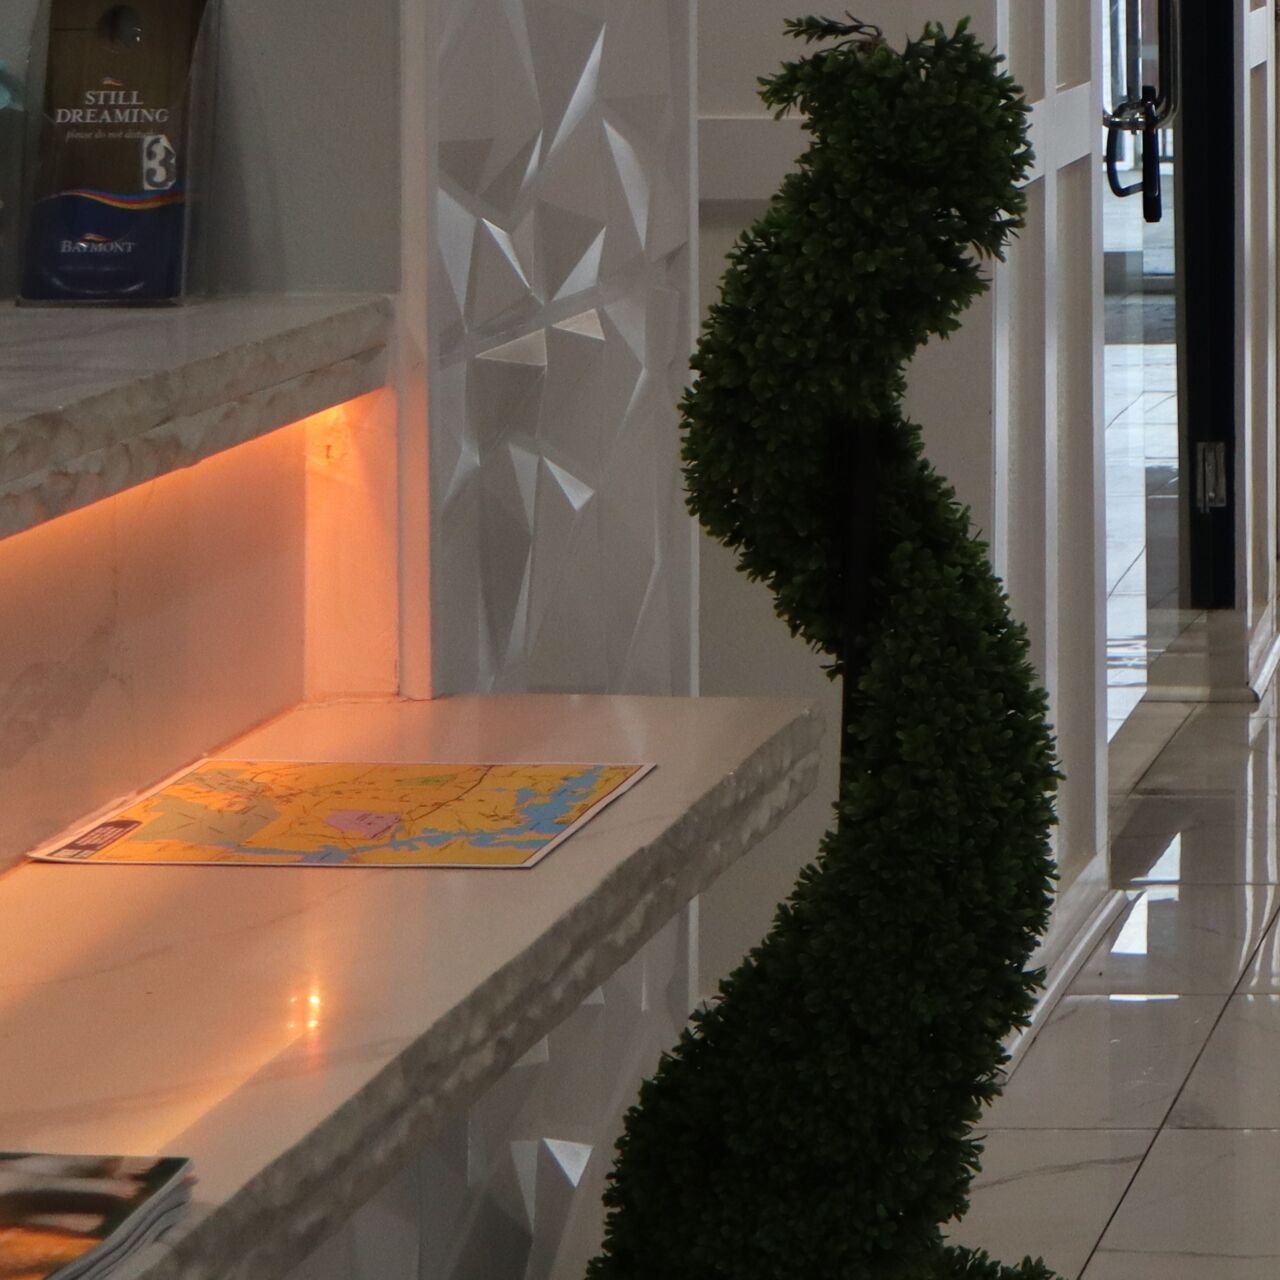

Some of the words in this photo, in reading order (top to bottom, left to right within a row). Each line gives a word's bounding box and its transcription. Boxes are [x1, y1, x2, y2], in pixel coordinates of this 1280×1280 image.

[84, 90, 144, 105] STILL
[55, 108, 170, 124] DREAMING
[146, 137, 176, 188] 3
